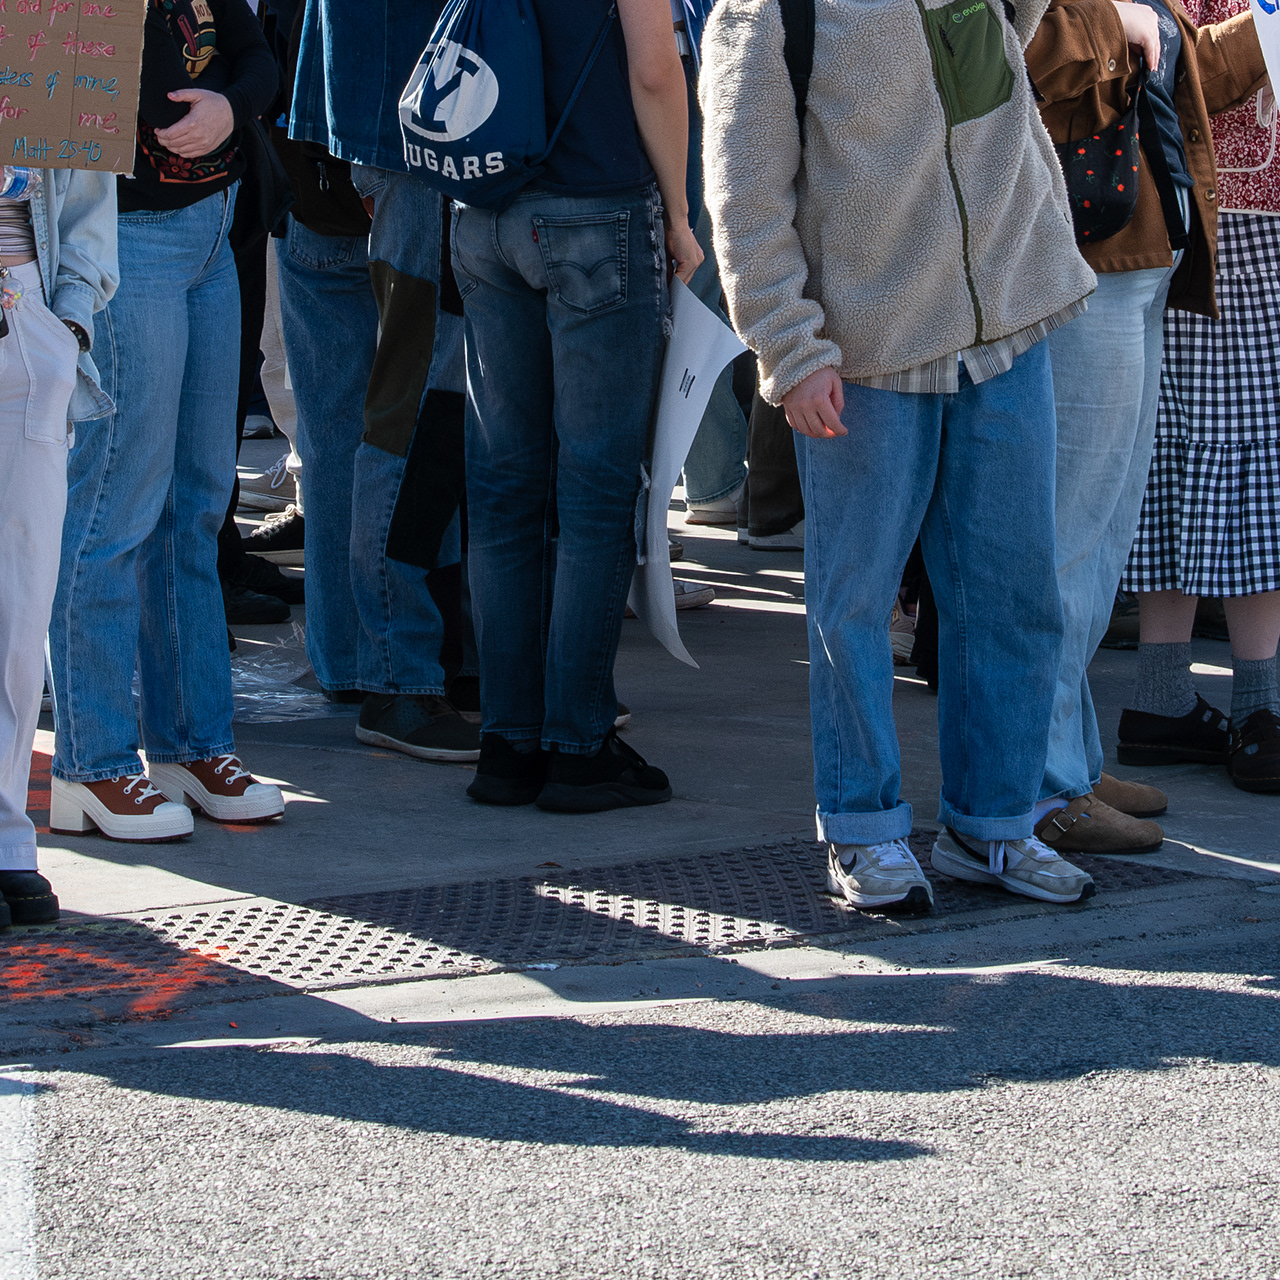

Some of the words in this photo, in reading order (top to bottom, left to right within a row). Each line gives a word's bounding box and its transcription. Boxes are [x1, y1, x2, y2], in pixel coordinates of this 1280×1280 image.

[81, 1, 117, 19] one
[27, 29, 50, 61] of
[62, 31, 117, 58] these
[45, 70, 61, 100] of
[74, 74, 121, 101] mine,
[78, 111, 121, 134] me.
[12, 137, 54, 161] Matt
